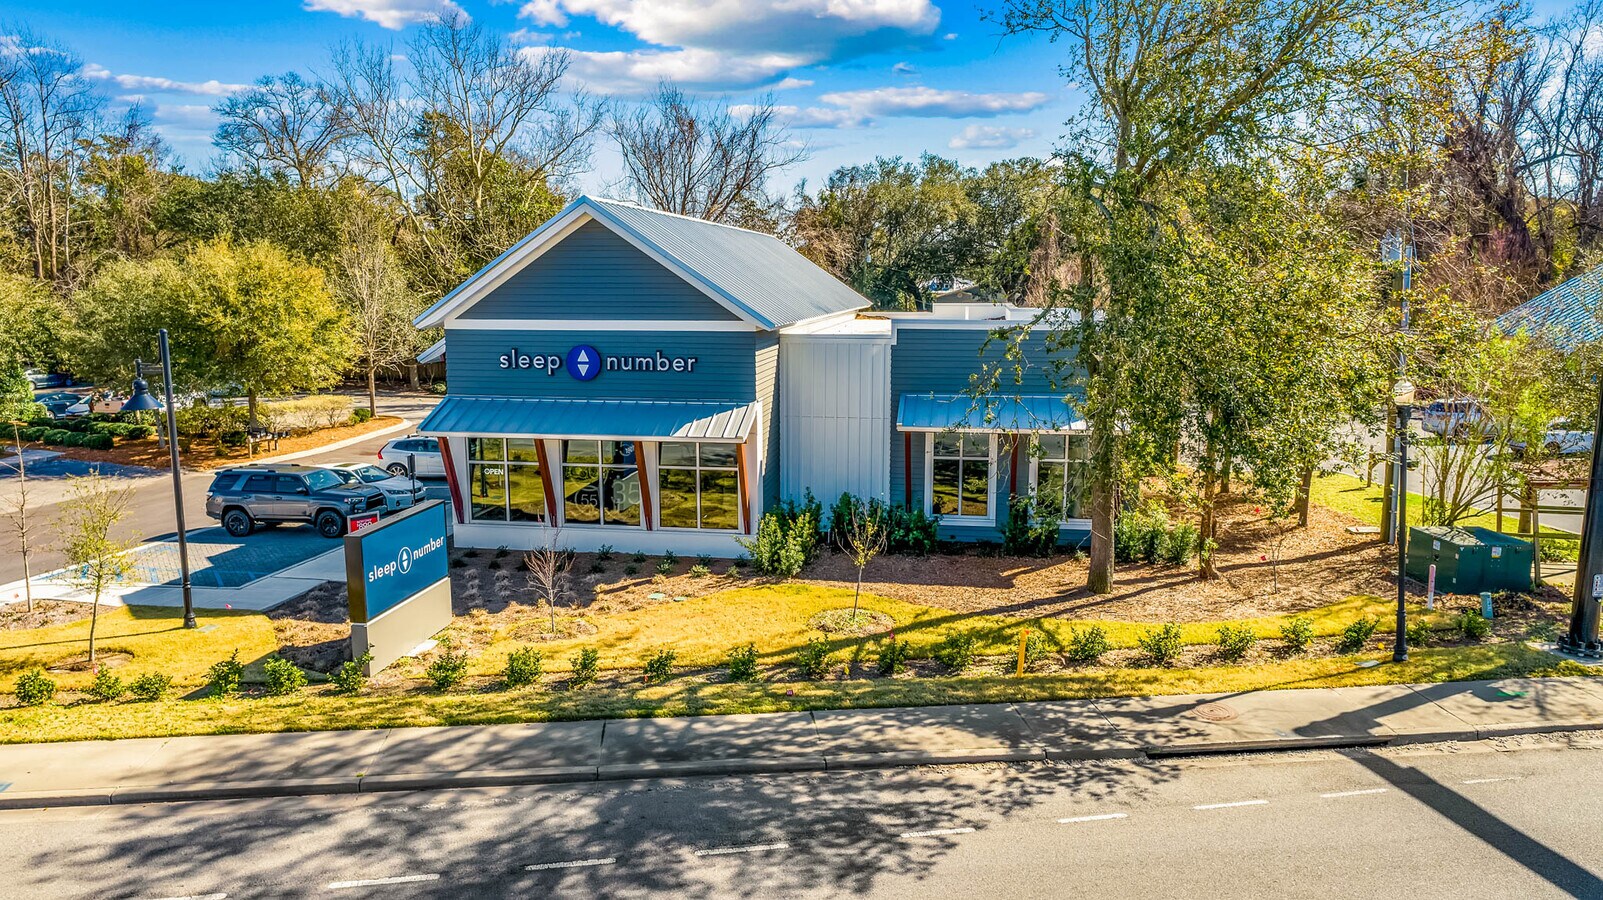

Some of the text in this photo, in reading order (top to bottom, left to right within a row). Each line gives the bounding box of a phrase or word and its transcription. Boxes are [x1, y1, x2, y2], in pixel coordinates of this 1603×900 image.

[500, 349, 697, 375] sleep number
[580, 493, 598, 507] 55
[611, 481, 641, 505] 35
[368, 536, 445, 583] sleep number
